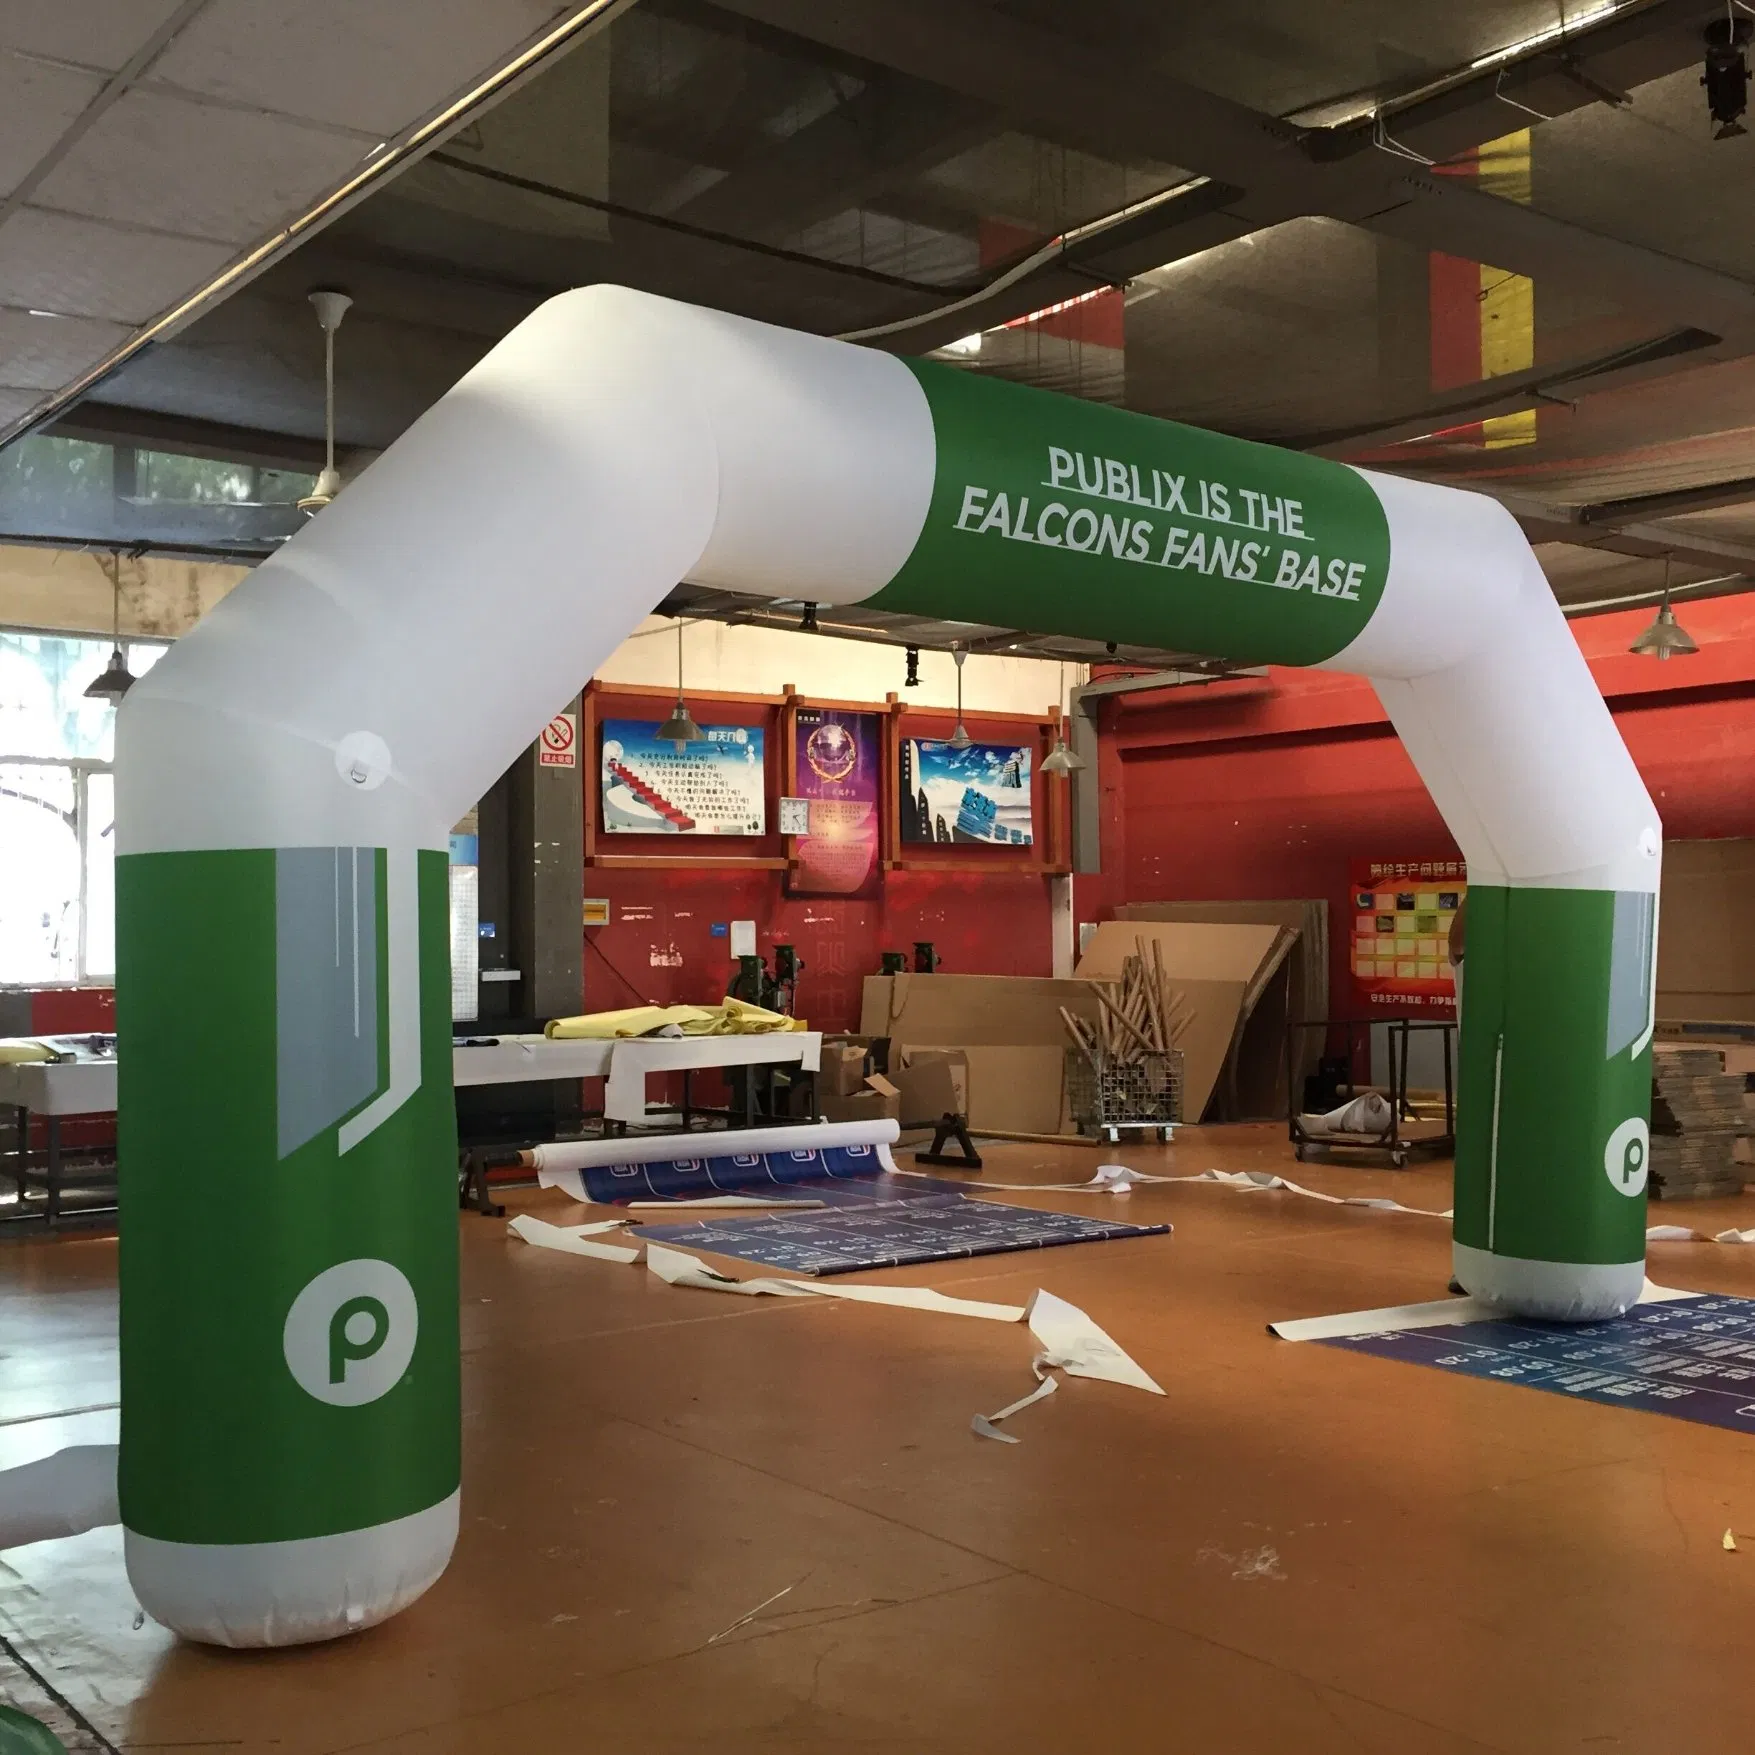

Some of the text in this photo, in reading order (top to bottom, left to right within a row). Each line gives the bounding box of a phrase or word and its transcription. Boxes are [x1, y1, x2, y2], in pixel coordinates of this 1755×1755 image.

[1047, 446, 1306, 538] PUBLIX IS THE
[956, 485, 1153, 561] FALCONS
[1273, 549, 1367, 602] BASE
[1434, 1349, 1499, 1365] 01.20
